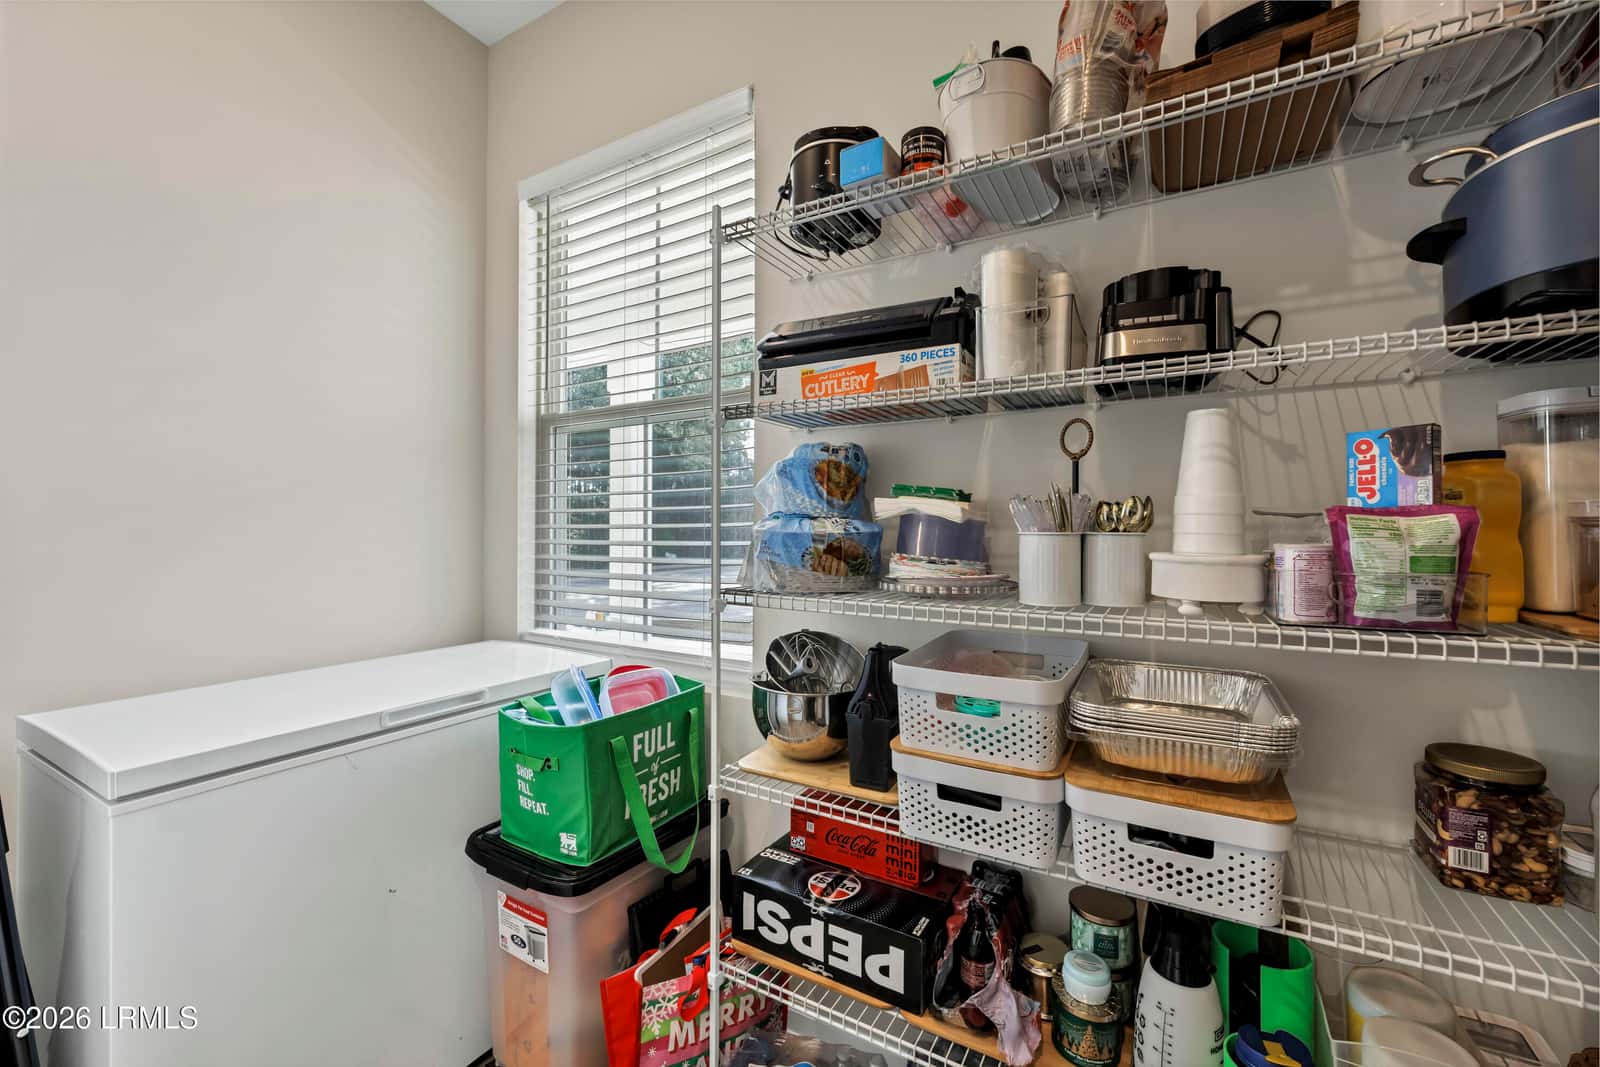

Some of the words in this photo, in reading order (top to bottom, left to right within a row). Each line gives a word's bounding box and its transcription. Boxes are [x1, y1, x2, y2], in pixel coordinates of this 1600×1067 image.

[899, 352, 918, 363] 360
[920, 346, 956, 360] PIECES
[804, 372, 871, 397] CUTLERY
[633, 721, 676, 764] FULL
[886, 845, 917, 861] mini
[886, 856, 917, 873] mini
[742, 891, 905, 995] PEPSI
